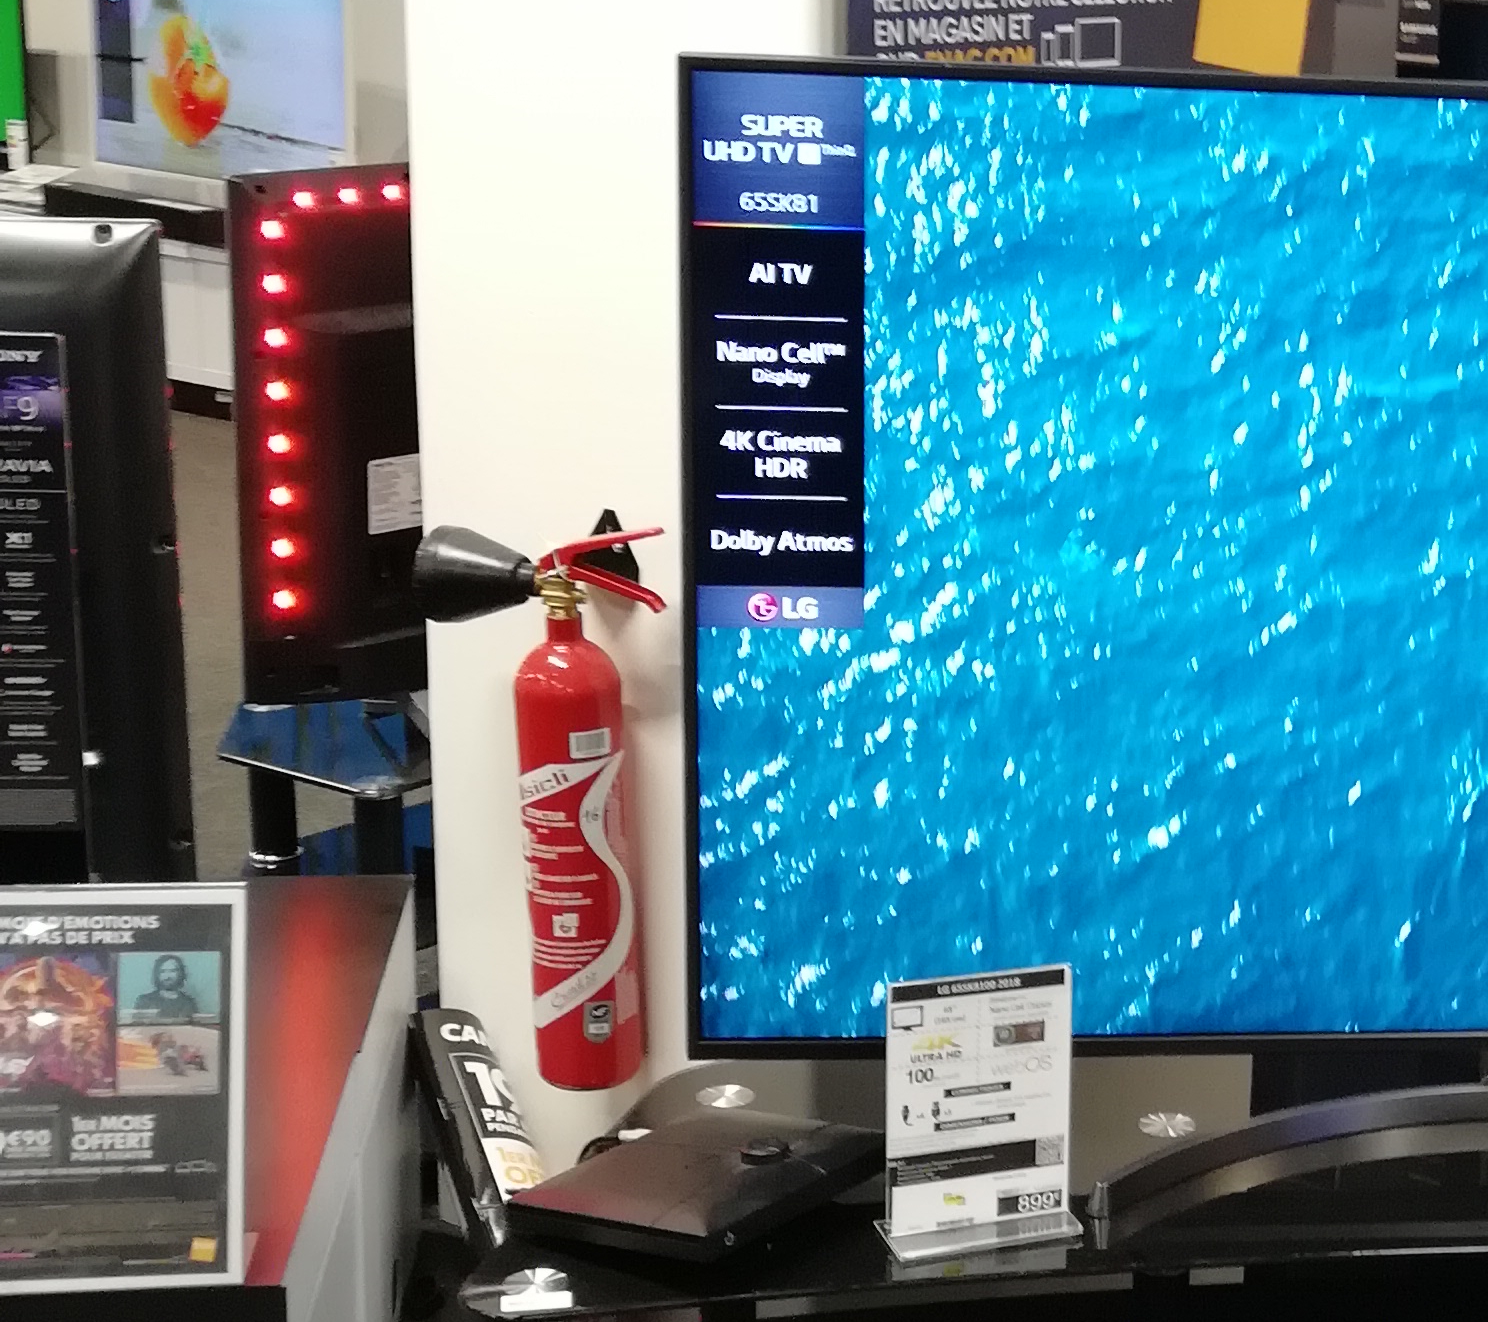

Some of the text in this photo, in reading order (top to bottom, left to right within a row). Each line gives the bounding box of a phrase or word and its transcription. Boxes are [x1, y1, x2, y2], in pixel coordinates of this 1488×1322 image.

[873, 12, 1035, 47] EN MAGASIN ET
[740, 114, 824, 139] SUPER
[702, 139, 756, 162] UHD
[757, 141, 795, 165] TV
[739, 192, 819, 214] 65SK81
[748, 262, 813, 285] AI TV
[716, 340, 777, 363] Nano
[751, 367, 811, 388] Display
[719, 429, 842, 453] 4K Cinema
[754, 456, 809, 479] HDR
[710, 529, 855, 556] Dolby Atmos
[782, 596, 819, 620] LG
[65, 931, 90, 945] DE
[91, 931, 136, 944] PRIX
[905, 1067, 934, 1085] 100
[71, 1132, 154, 1151] OFFERT
